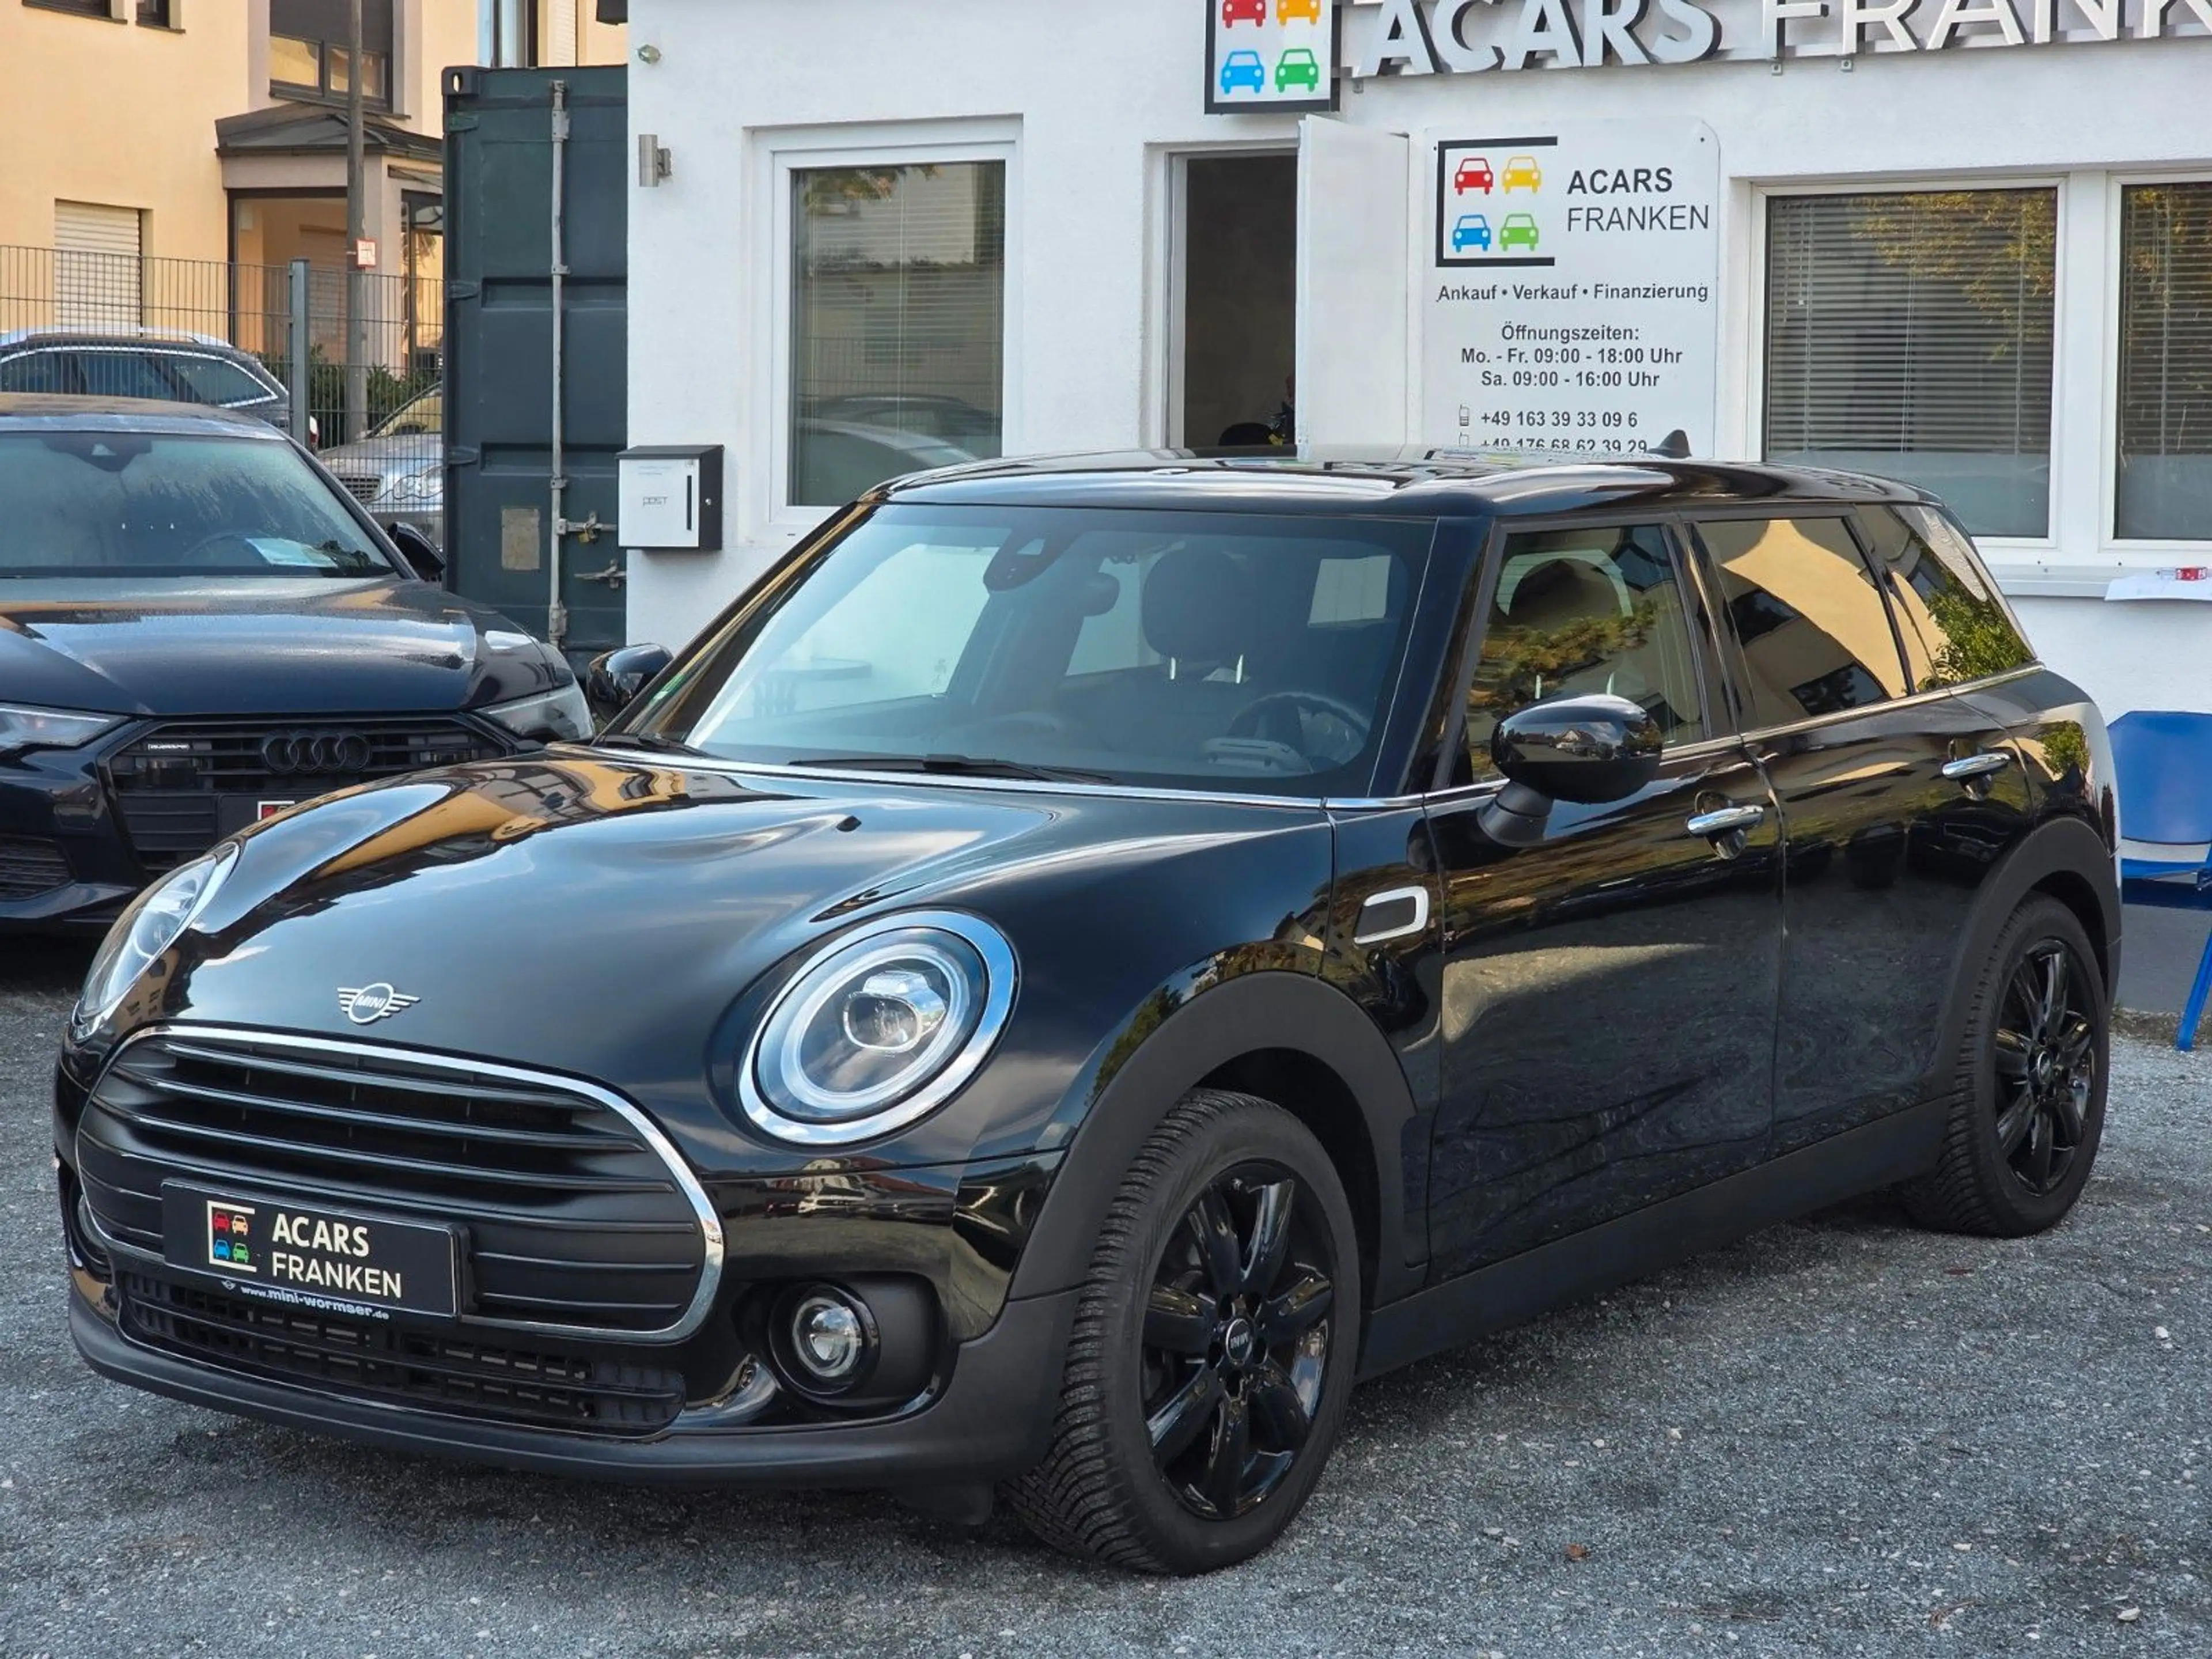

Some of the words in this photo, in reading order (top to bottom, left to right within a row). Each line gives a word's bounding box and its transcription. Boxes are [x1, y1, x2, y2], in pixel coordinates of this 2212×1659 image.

[1353, 0, 1722, 77] ACARS
[1567, 167, 1672, 195] ACARS
[1568, 204, 1709, 232] FRANKEN
[1438, 285, 1497, 301] Ankauf
[1513, 284, 1578, 300] Verkauf
[1594, 283, 1709, 302] Finanzierung
[1501, 320, 1639, 344] Öffnungszeiten:
[1461, 348, 1490, 363] Mo.
[1508, 347, 1528, 363] Fr.
[1535, 347, 1580, 363] 09:00
[1598, 347, 1643, 363] 18:00
[1650, 347, 1683, 363] Uhr
[1482, 370, 1507, 386] Sa.
[1513, 370, 1558, 387] 09:00
[1576, 371, 1622, 387] 16:00
[1628, 371, 1660, 387] Uhr
[1481, 410, 1510, 426] +49
[1517, 411, 1545, 426] 163
[1551, 411, 1570, 426] 39
[1577, 411, 1596, 427] 33
[1603, 411, 1622, 427] 09
[1628, 411, 1637, 427] 6
[272, 1213, 369, 1257] ACARS
[272, 1251, 402, 1298] FRANKEN
